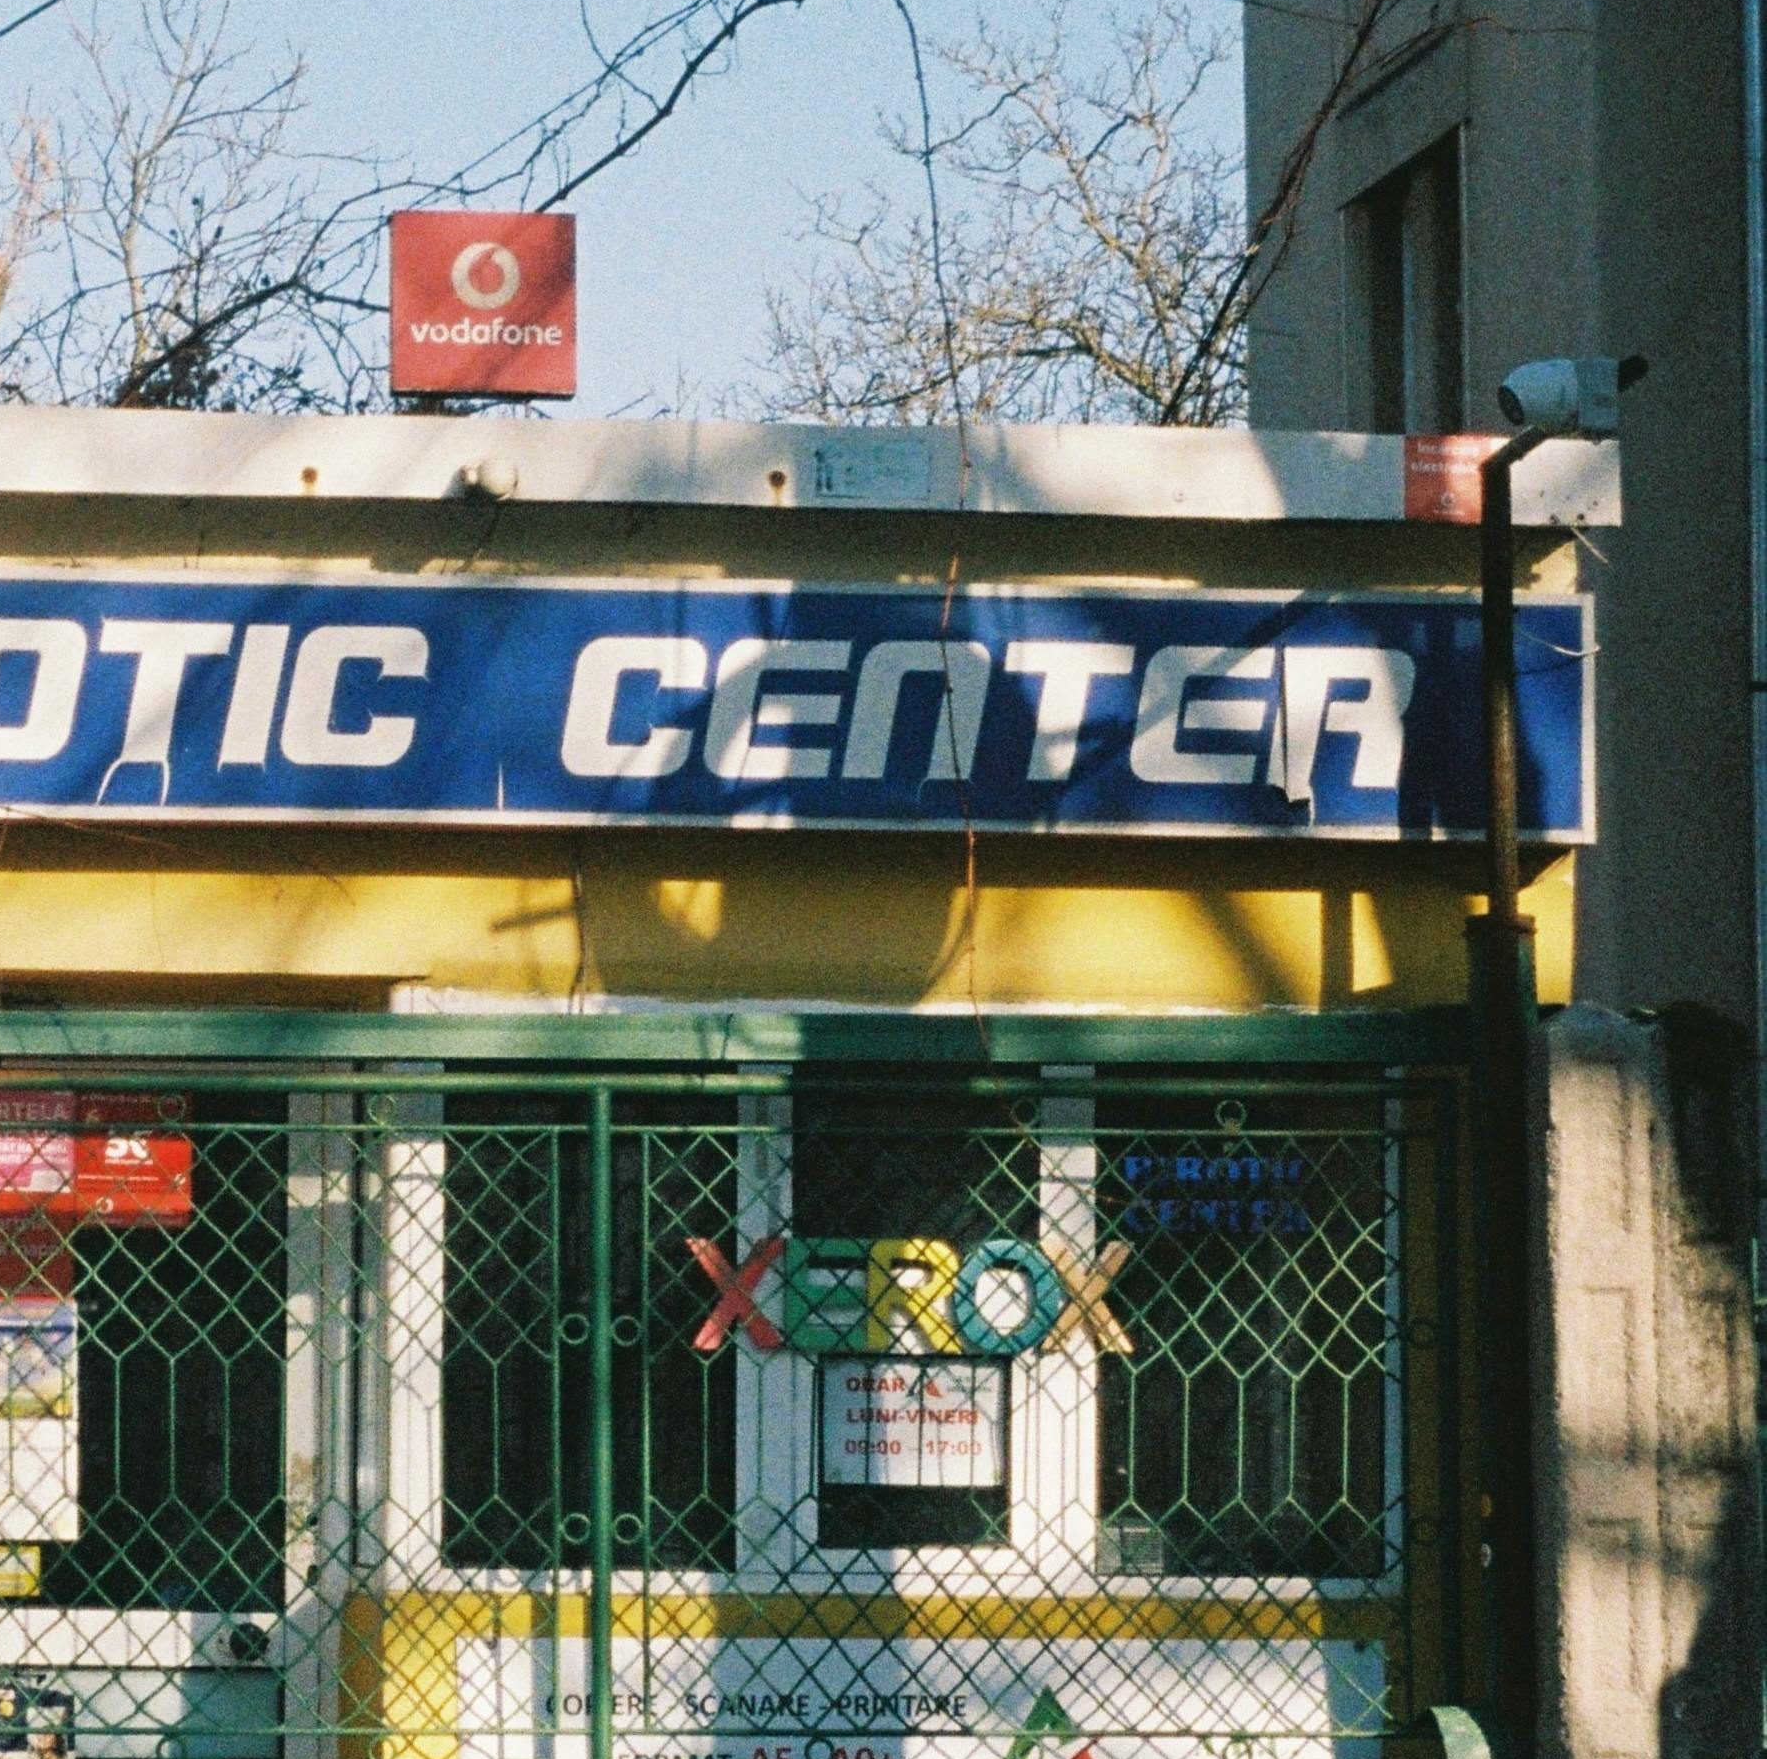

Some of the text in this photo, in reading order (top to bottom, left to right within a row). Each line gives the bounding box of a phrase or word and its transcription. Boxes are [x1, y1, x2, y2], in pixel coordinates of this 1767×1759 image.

[410, 317, 563, 346] vodafone
[560, 636, 1416, 789] CENTER
[685, 1237, 1134, 1353] XEROX
[926, 1440, 982, 1455] 17:00
[545, 1693, 659, 1716] COERE
[685, 1693, 811, 1717] SCANARE
[837, 1694, 968, 1717] PRINTARE
